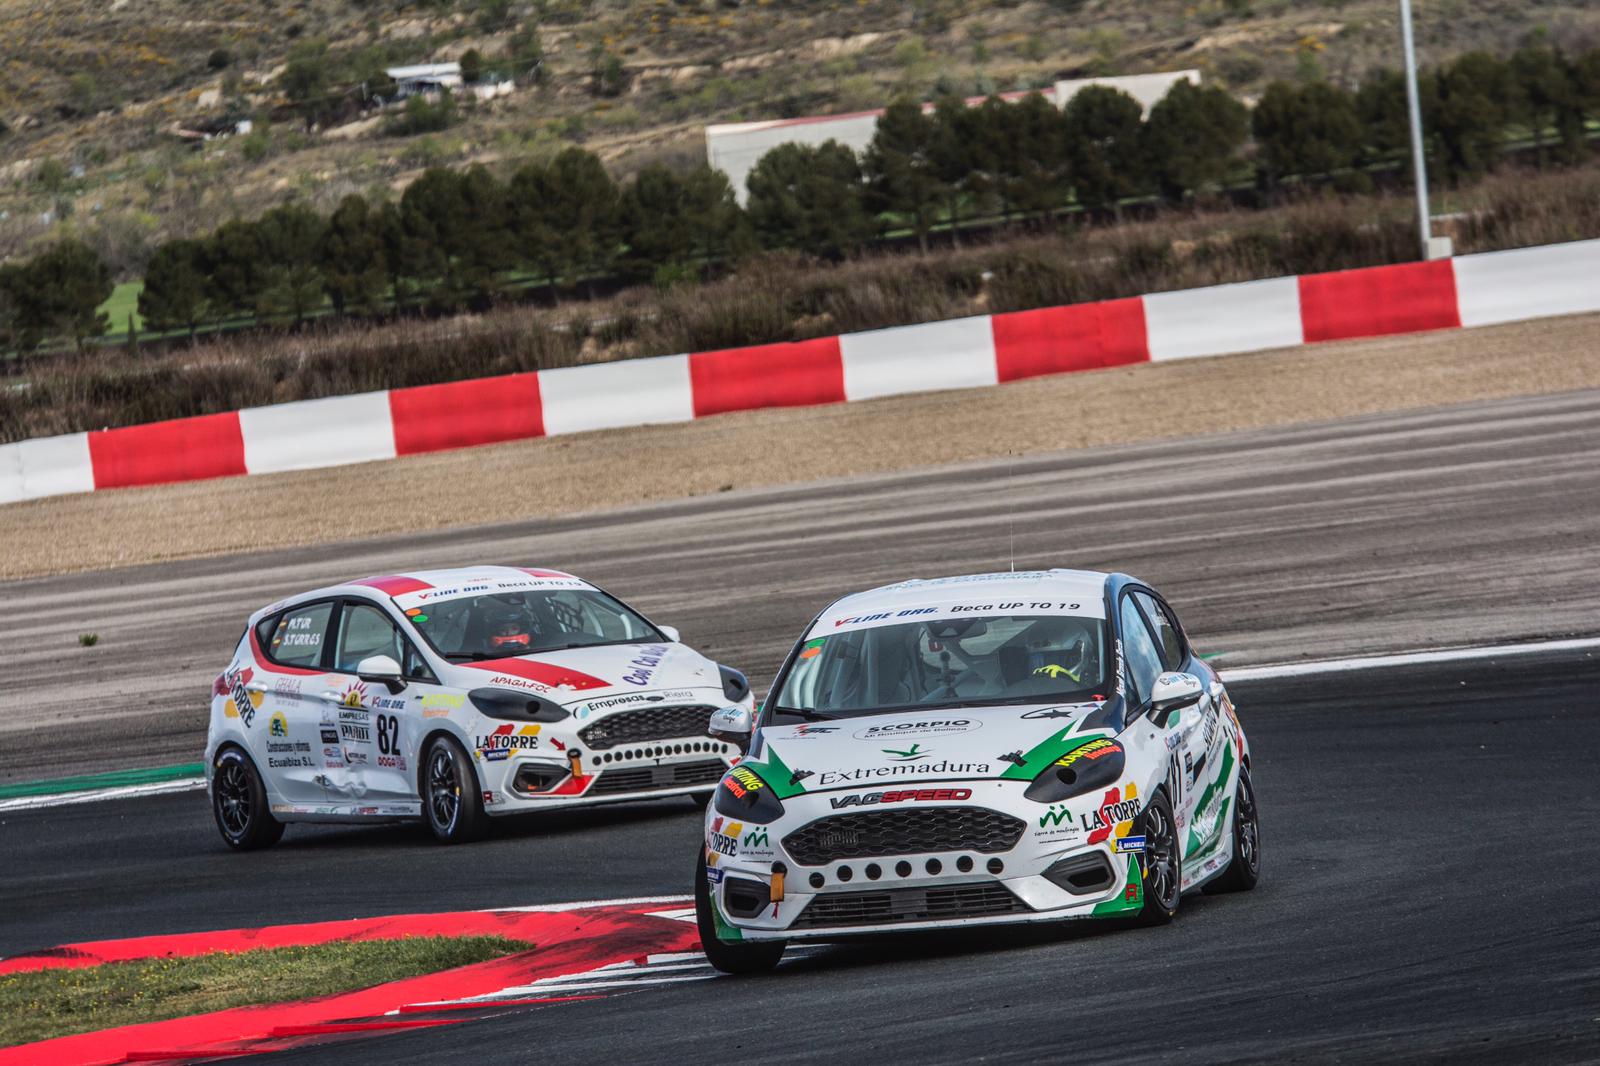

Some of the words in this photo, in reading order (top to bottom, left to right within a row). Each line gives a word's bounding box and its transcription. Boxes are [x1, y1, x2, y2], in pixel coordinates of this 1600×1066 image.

[951, 603, 993, 613] Beca
[998, 602, 1024, 610] UP
[587, 695, 647, 711] Empresas
[377, 714, 401, 756] 82
[867, 719, 970, 733] SCORPIO
[475, 735, 490, 749] LA
[493, 735, 539, 749] TORRE
[1054, 739, 1113, 767] KARTING
[819, 760, 990, 786] Extremadura
[1080, 810, 1106, 832] LA
